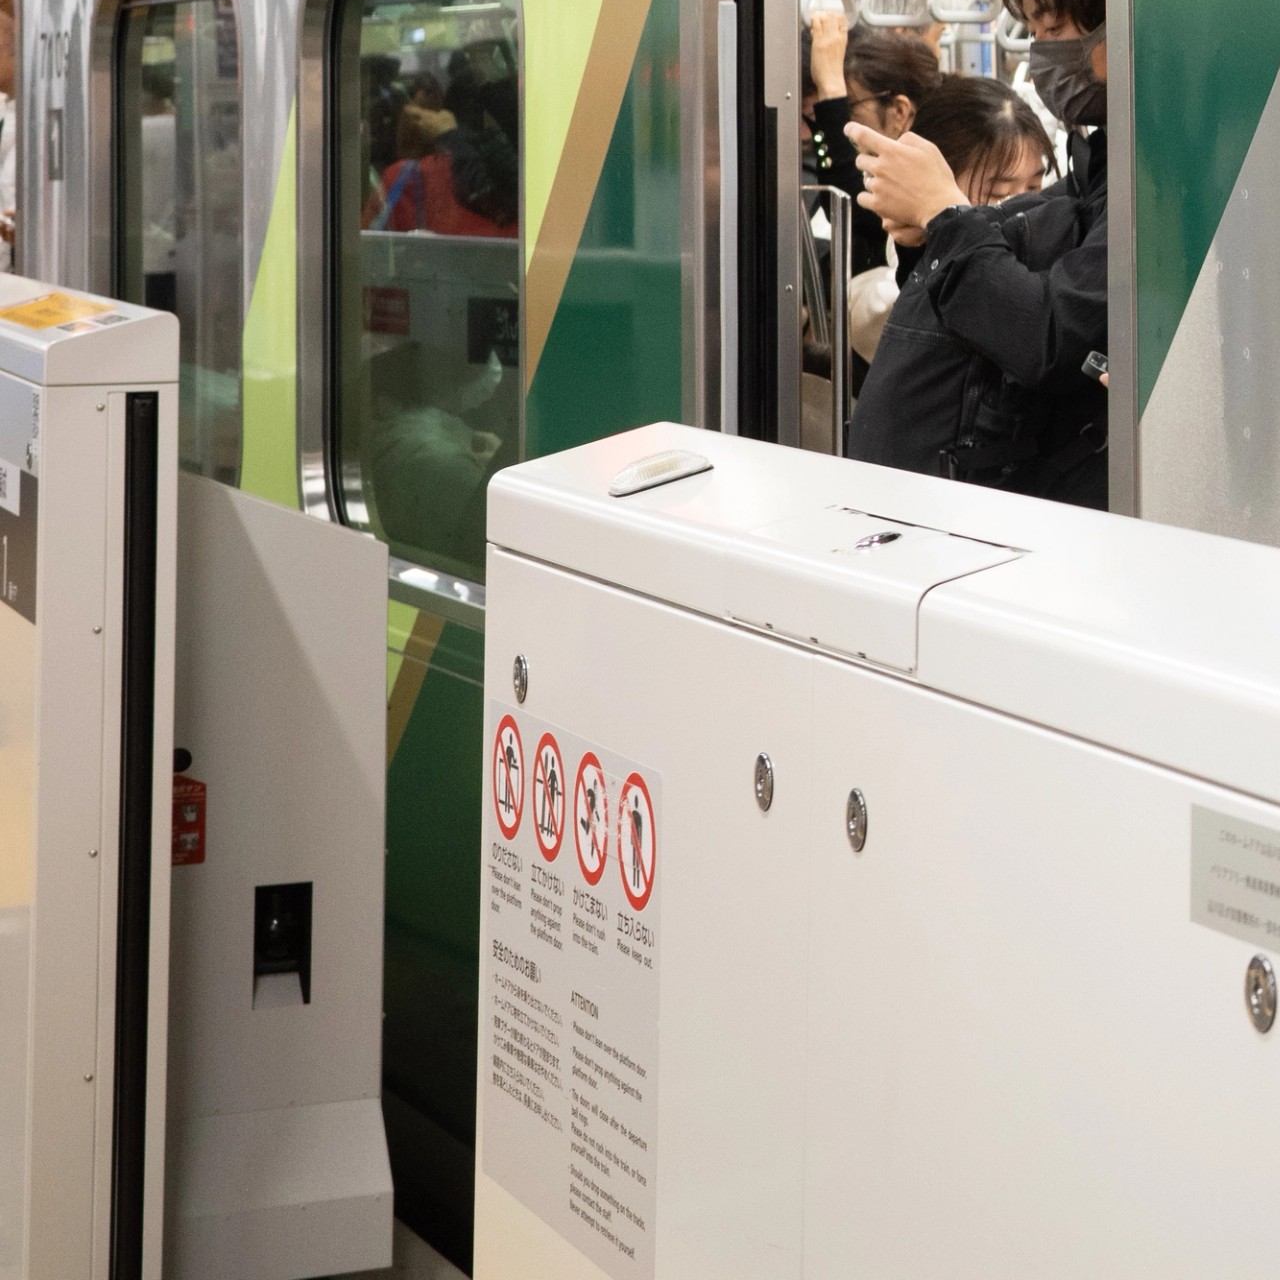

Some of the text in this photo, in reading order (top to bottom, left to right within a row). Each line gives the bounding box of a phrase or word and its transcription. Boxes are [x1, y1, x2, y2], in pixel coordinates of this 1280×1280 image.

[531, 864, 565, 897] 立てかけない
[573, 886, 608, 921] かけこまない
[617, 912, 655, 948] 立ち入らない
[492, 939, 542, 984] 安全のためのお願い
[616, 938, 653, 970] Please keep out.
[570, 990, 599, 1020] ATTENTION
